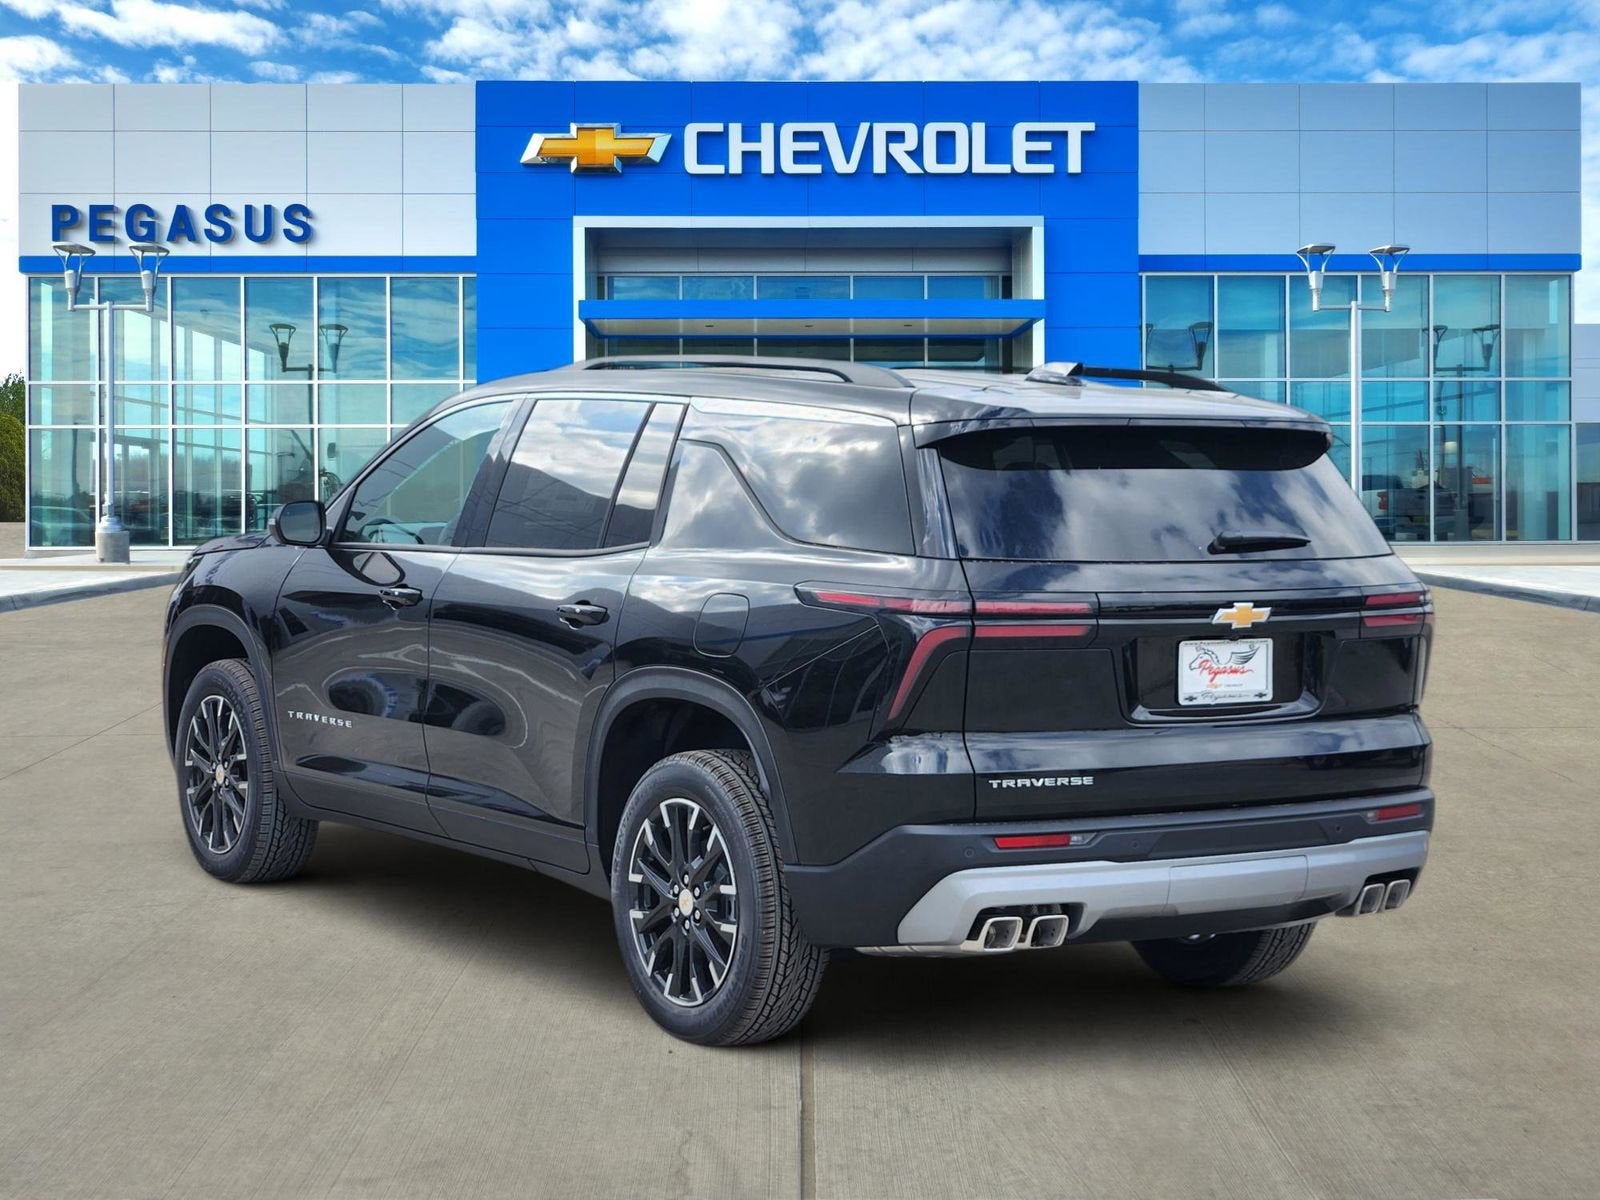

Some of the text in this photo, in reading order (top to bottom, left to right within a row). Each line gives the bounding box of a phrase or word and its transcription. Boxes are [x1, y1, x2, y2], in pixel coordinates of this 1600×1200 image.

[684, 121, 1095, 175] CHEVROLET
[51, 203, 315, 244] PEGASUS
[1199, 658, 1255, 684] Pegasus
[287, 710, 353, 728] TRAVERSE
[988, 776, 1094, 789] TRAVERSE
